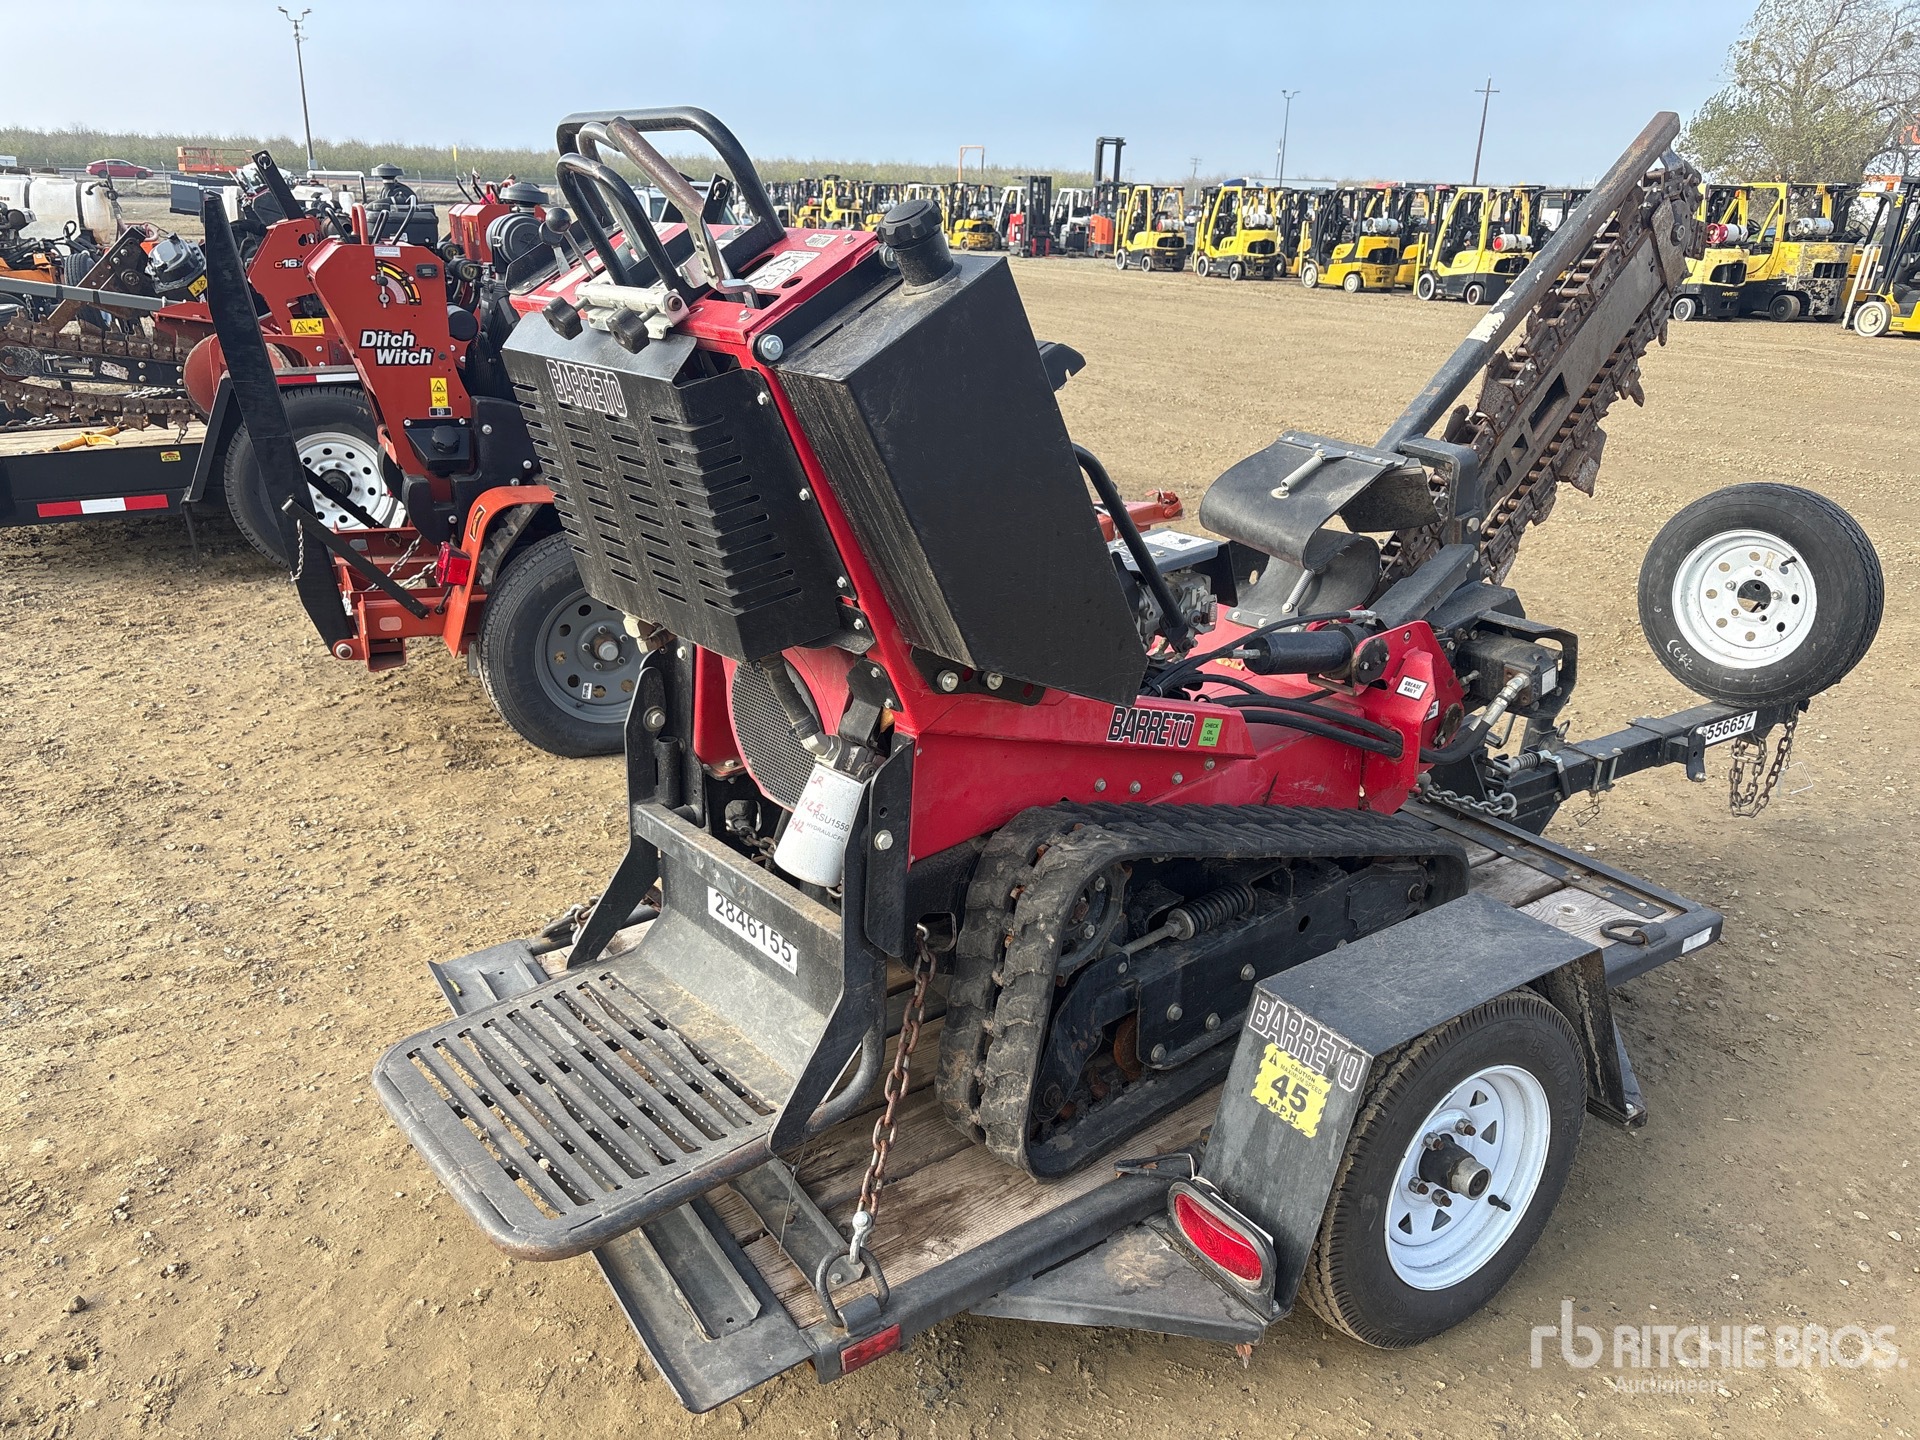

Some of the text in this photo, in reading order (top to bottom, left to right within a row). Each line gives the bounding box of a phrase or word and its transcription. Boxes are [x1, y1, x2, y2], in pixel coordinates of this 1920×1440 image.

[360, 330, 416, 347] Ditch
[376, 348, 433, 365] Witch
[545, 358, 628, 418] BARRETO
[1404, 680, 1423, 690] GREASE
[1105, 705, 1197, 748] BARRETO
[806, 822, 838, 840] HYDRAULIC
[714, 892, 792, 963] 2846155
[1248, 994, 1366, 1092] BARRETO
[1280, 1064, 1323, 1095] MAXIMUM SPEED
[1290, 1063, 1316, 1084] CAUTION
[1270, 1074, 1310, 1113] 45
[1268, 1096, 1299, 1125] M.P.H.
